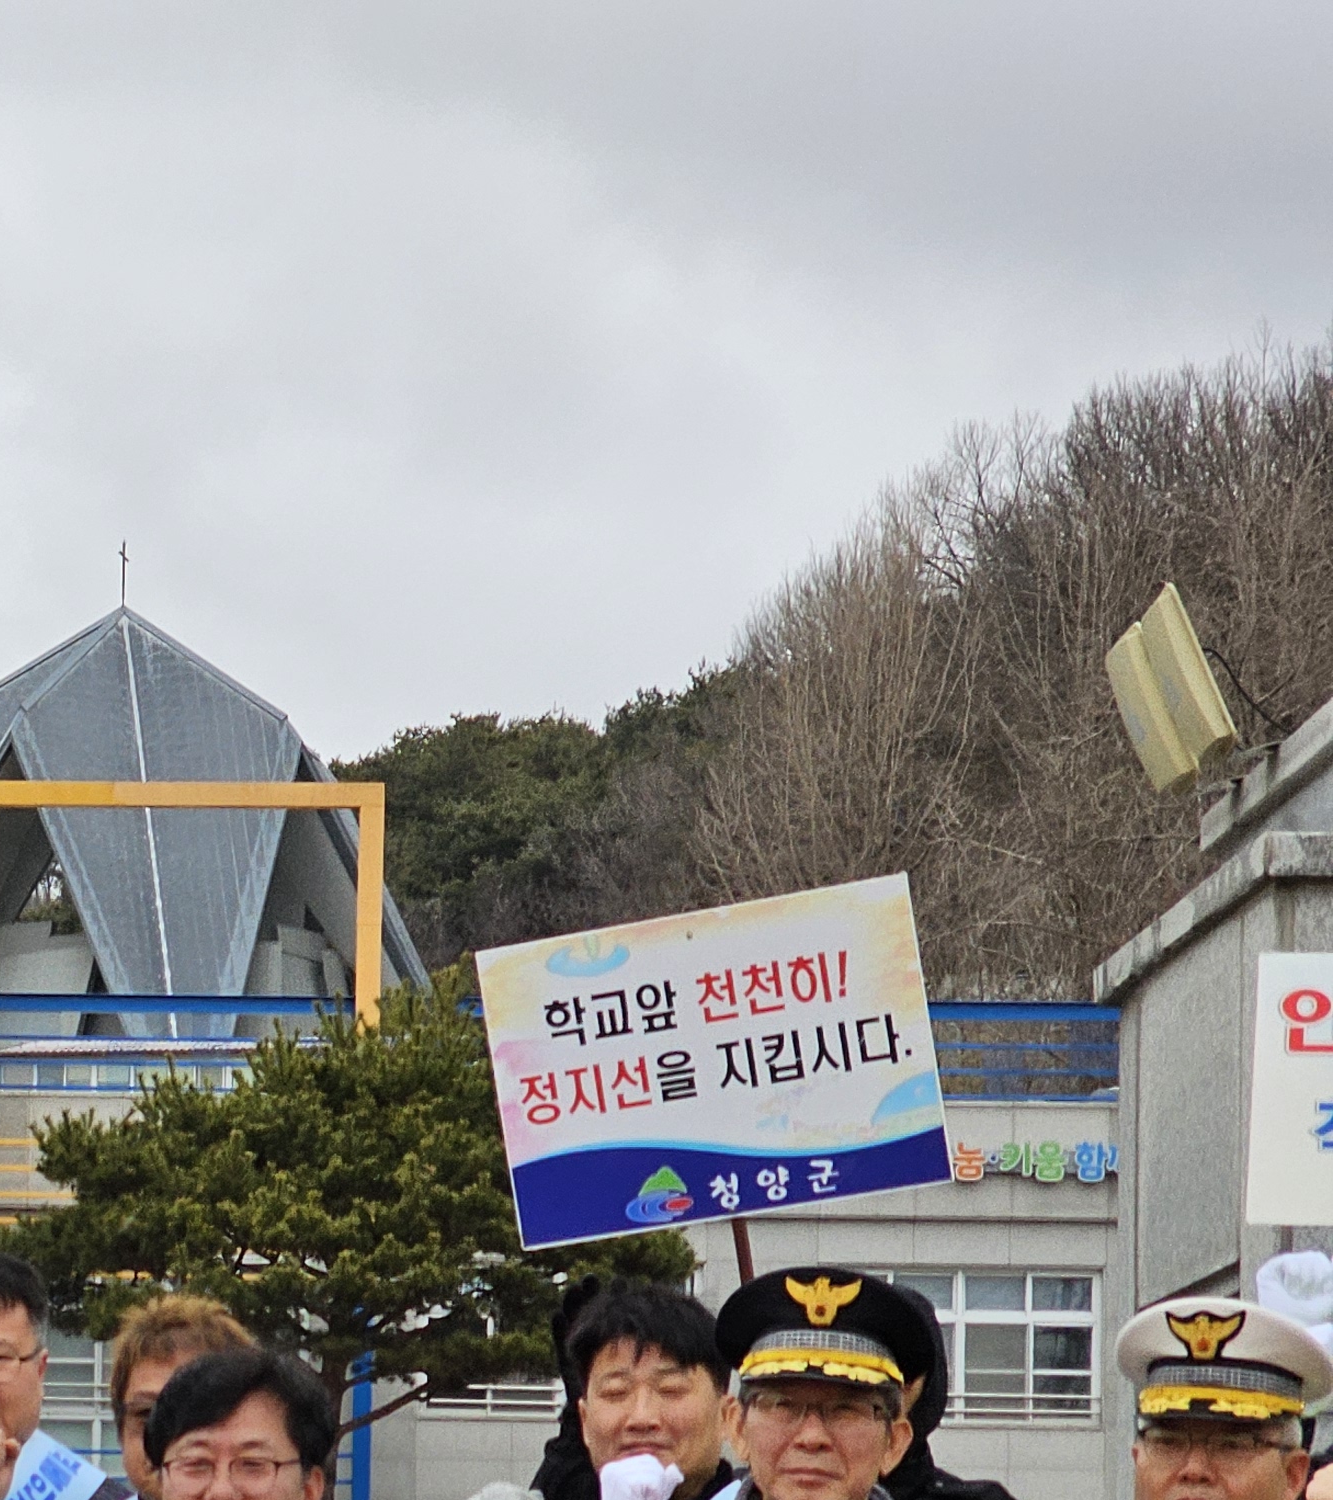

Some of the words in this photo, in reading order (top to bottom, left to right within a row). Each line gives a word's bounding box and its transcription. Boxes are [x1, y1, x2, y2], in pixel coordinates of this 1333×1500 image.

[544, 979, 678, 1046] 학교앞
[695, 950, 849, 1024] 천천히!
[519, 1048, 698, 1126] 정지선을
[716, 1013, 913, 1089] 지킵시다.
[709, 1159, 840, 1209] 청양군
